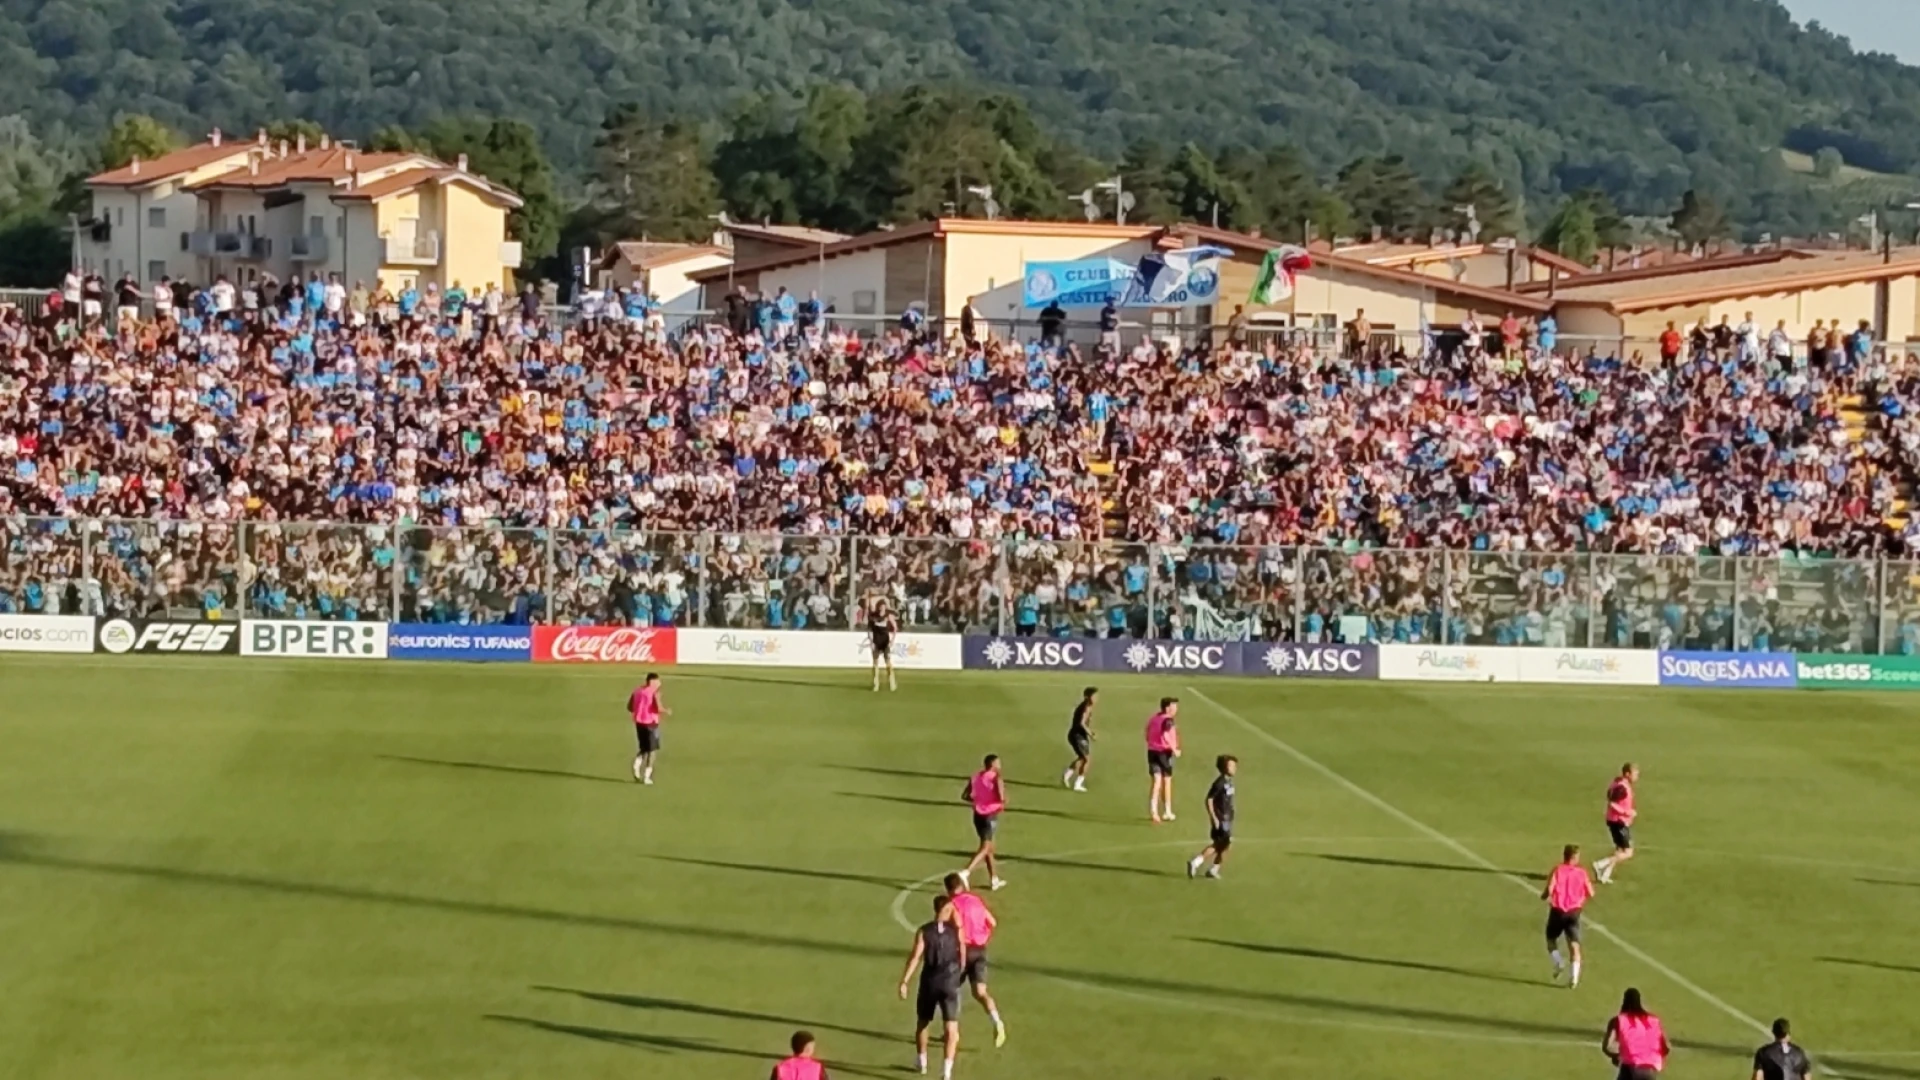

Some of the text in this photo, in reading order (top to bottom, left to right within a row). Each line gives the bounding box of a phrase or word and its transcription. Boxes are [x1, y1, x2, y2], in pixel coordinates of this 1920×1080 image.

[1065, 268, 1110, 281] CLUB
[400, 634, 530, 649] euronics TUFANO
[1014, 641, 1084, 666] MSC
[1154, 645, 1224, 669] MSC
[1294, 647, 1362, 672] MSC
[1797, 662, 1872, 681] bet365
